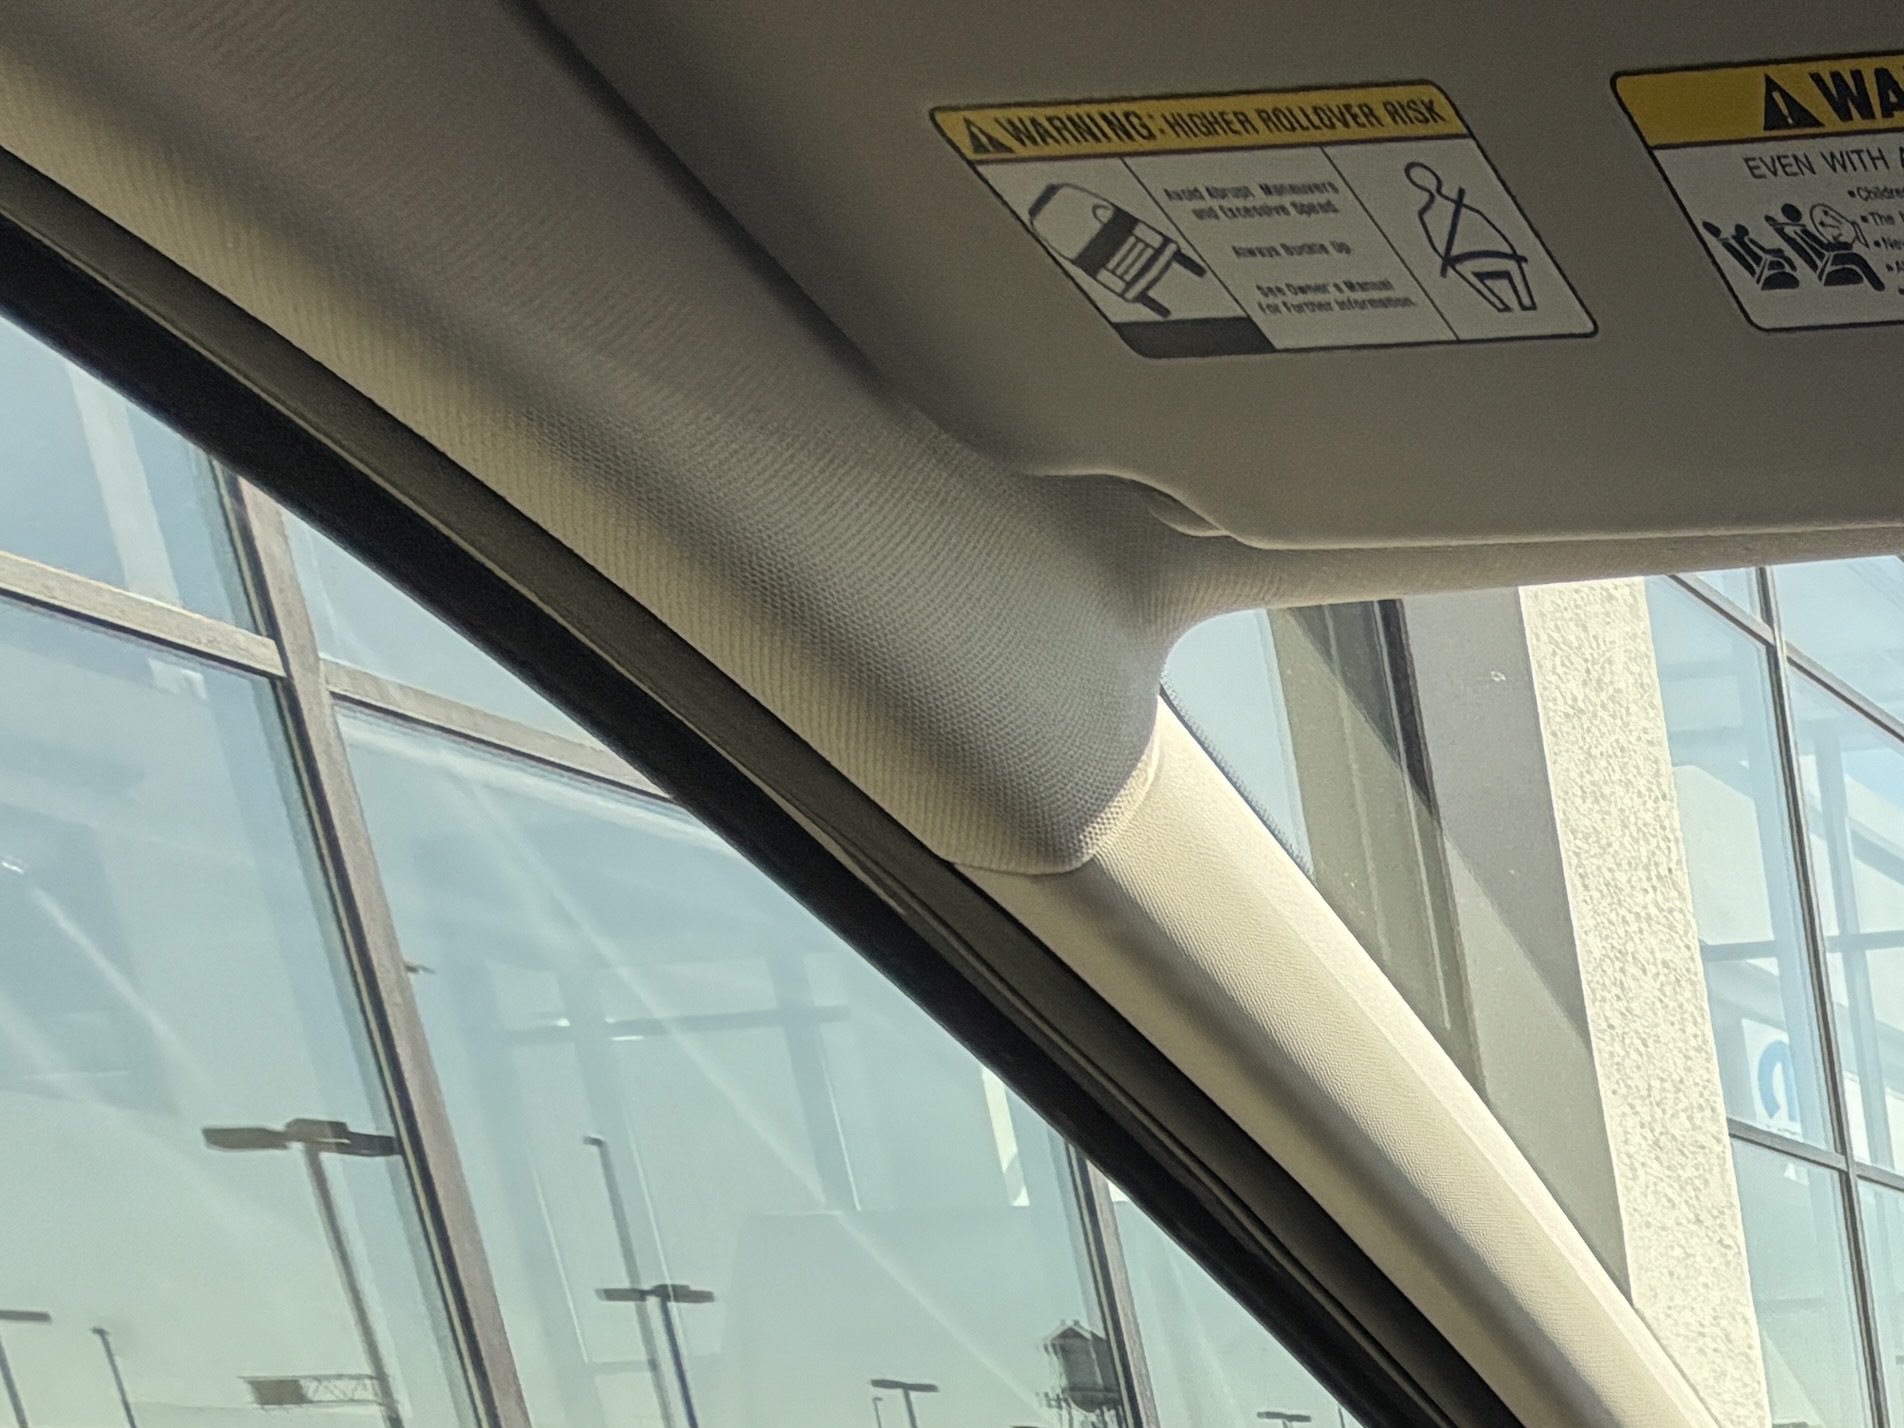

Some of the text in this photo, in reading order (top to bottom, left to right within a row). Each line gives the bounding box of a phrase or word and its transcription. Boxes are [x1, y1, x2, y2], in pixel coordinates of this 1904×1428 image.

[996, 98, 1445, 147] WARNING: HIGHER ROLLOVER RISK
[1742, 154, 1814, 181] EVEN
[1819, 148, 1890, 177] WITH
[1869, 212, 1897, 226] The
